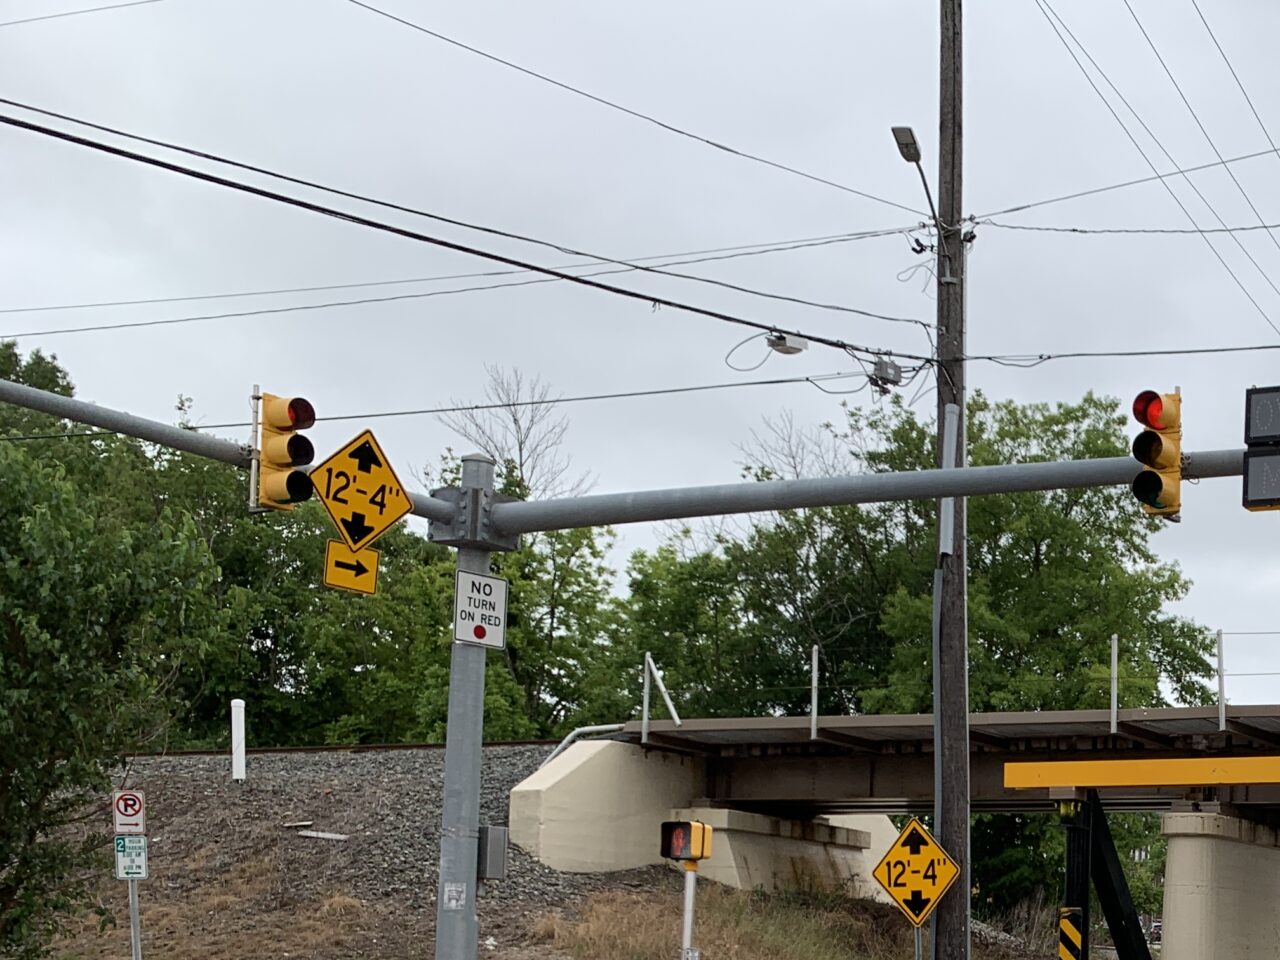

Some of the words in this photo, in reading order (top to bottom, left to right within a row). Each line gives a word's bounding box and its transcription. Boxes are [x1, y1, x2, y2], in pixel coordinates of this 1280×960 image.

[470, 579, 493, 597] NO
[466, 596, 496, 612] TURN
[459, 609, 475, 624] ON
[480, 612, 501, 627] RED
[117, 839, 125, 851] 2
